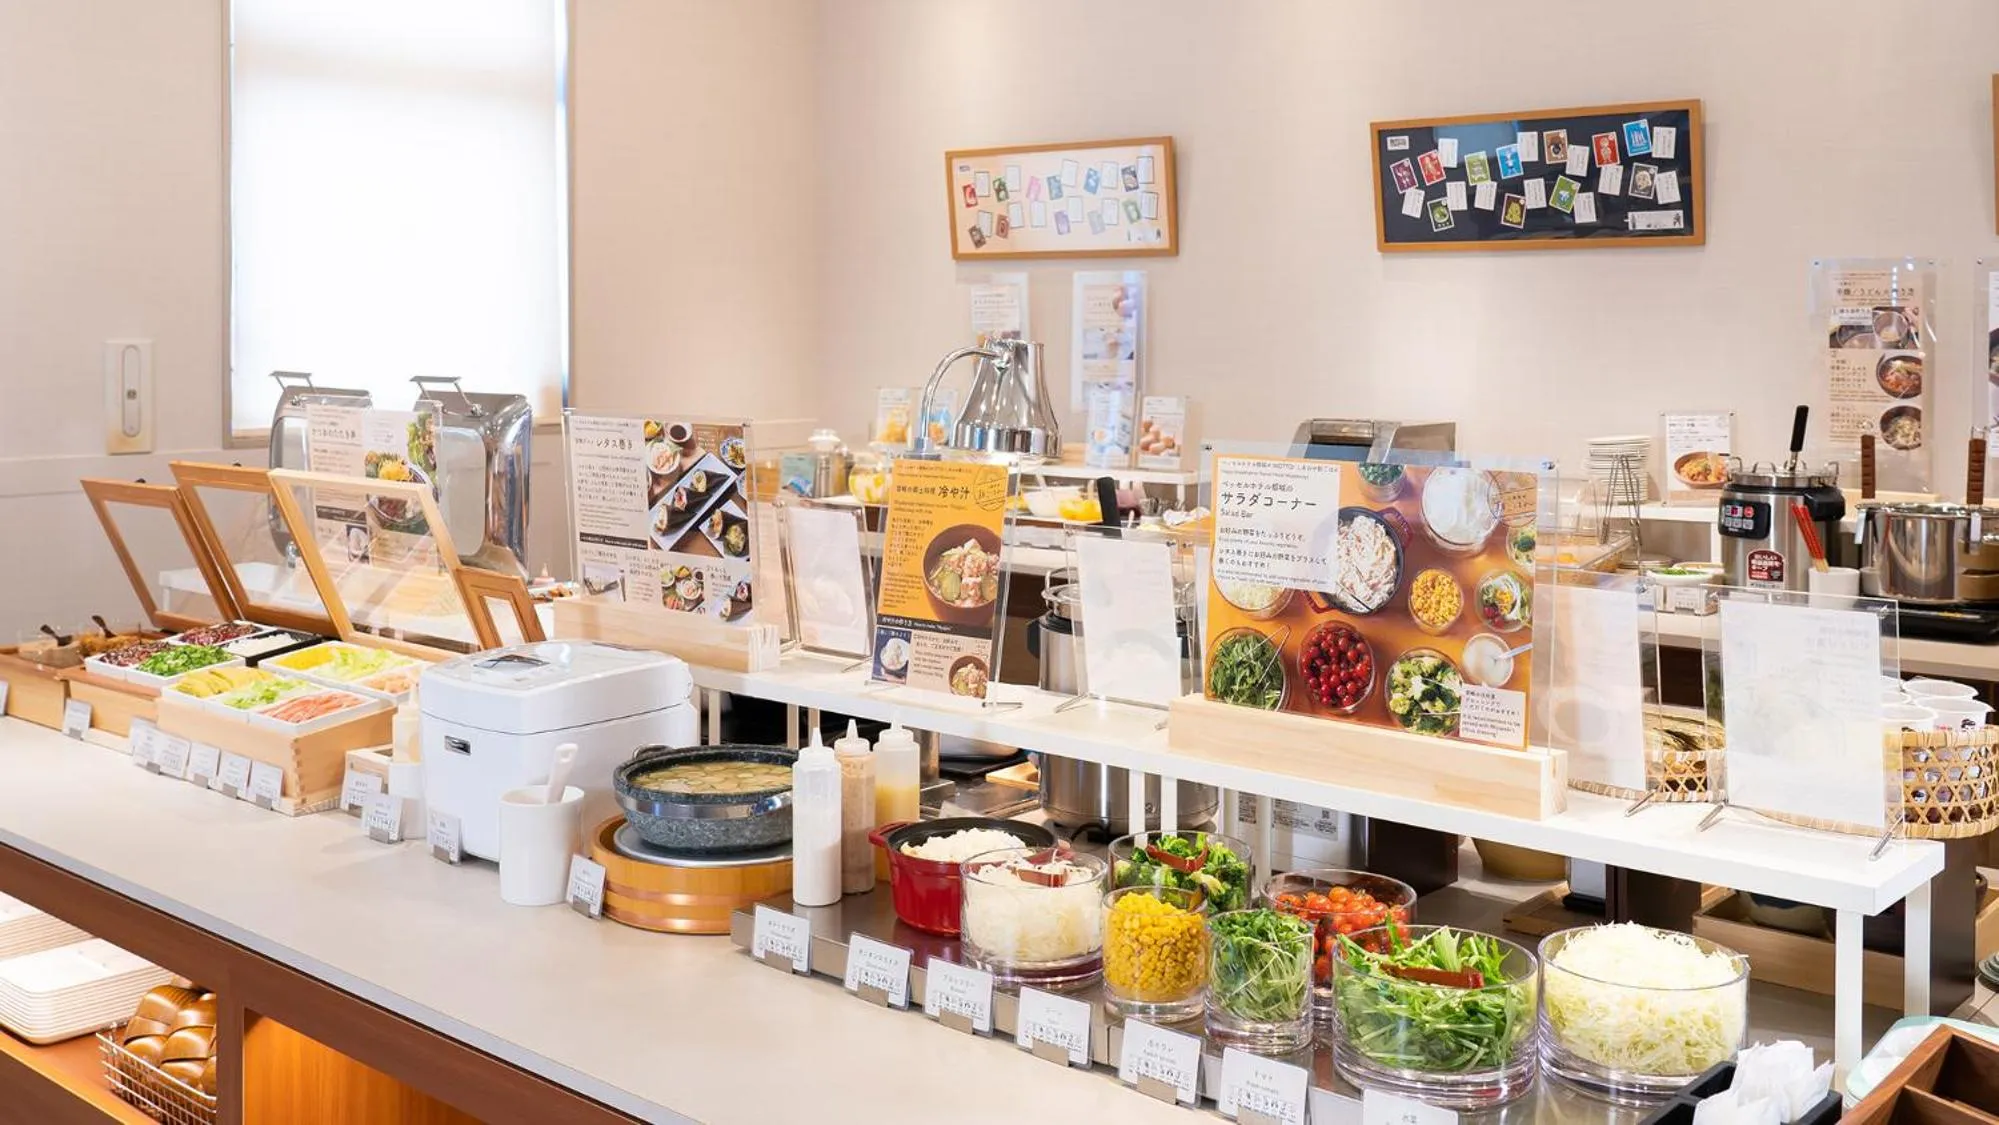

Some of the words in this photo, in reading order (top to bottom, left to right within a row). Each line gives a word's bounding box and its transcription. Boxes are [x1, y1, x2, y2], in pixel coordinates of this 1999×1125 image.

[596, 437, 633, 450] レタス巻き
[938, 484, 971, 499] 冷や汁
[1222, 480, 1294, 492] ベッセルホテル都城の
[1221, 491, 1317, 510] サラダコーナー
[1220, 508, 1240, 518] Salad
[1241, 510, 1254, 519] Bar
